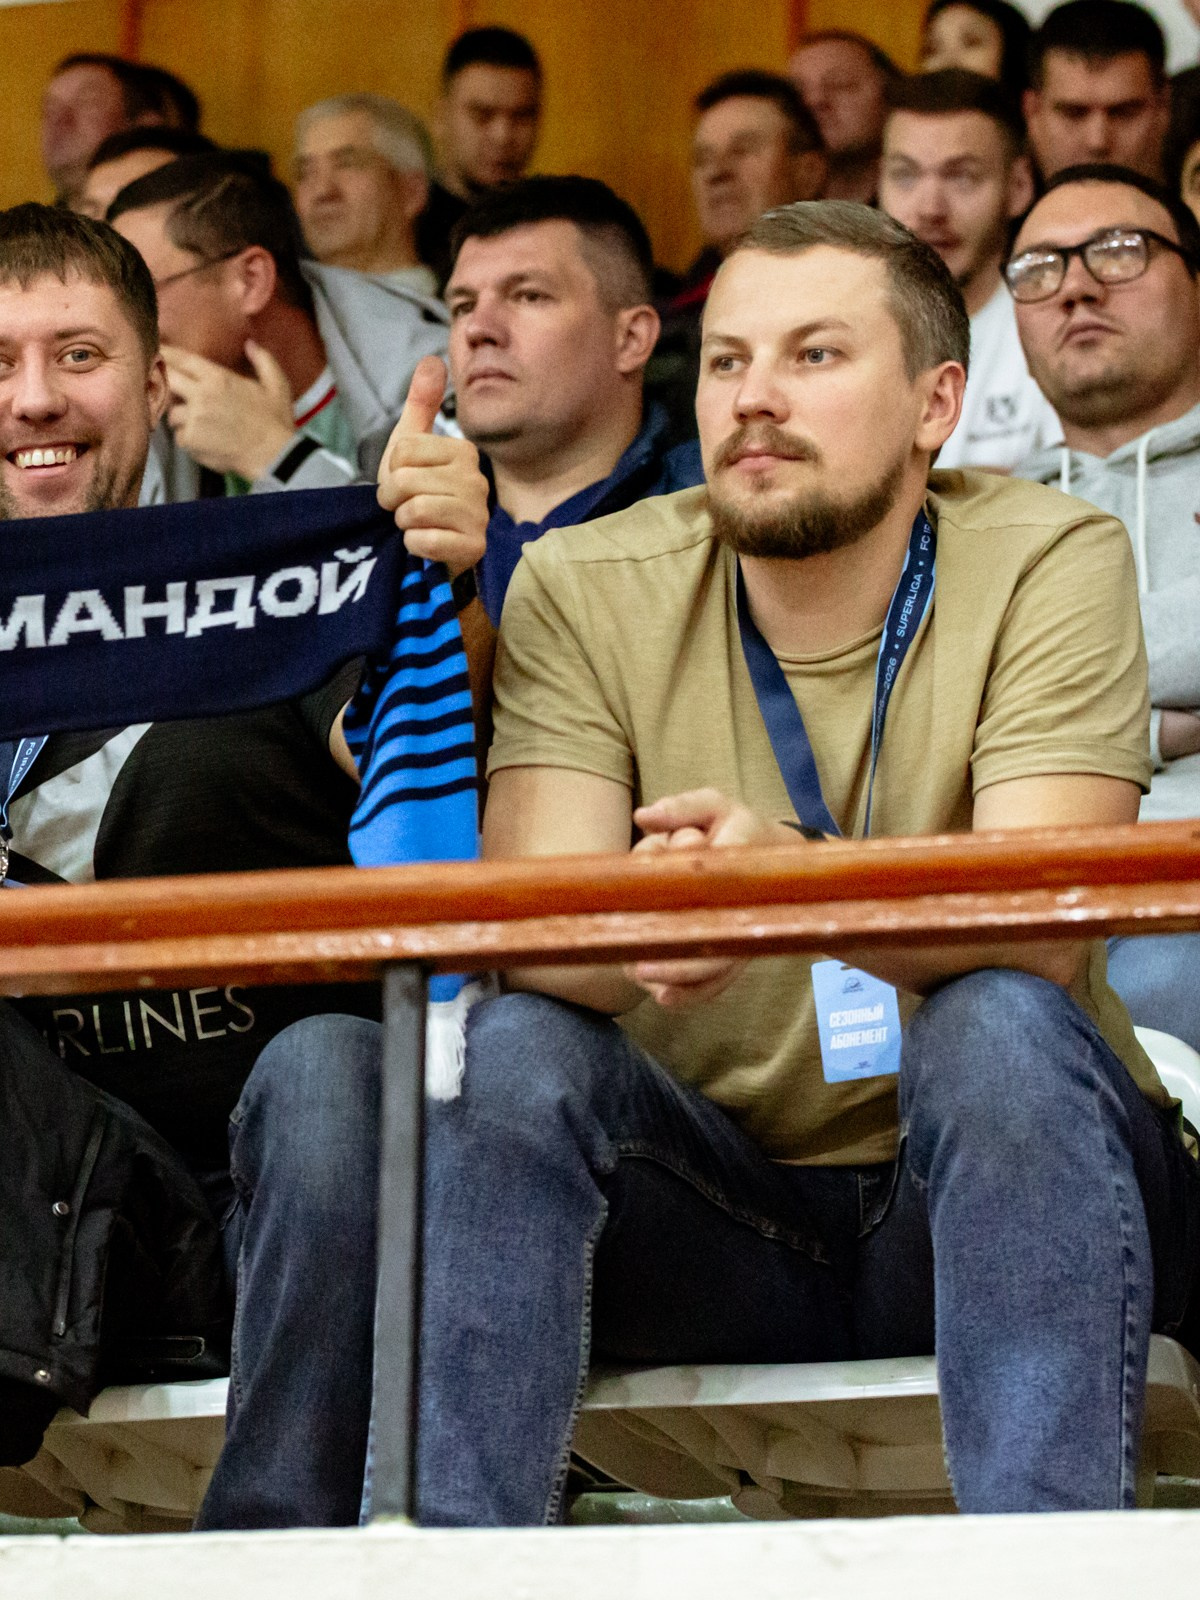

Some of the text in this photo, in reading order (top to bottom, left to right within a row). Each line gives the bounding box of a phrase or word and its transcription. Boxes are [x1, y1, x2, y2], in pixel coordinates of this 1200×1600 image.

[896, 573, 923, 638] SUPERLIGA
[919, 534, 931, 551] FC
[43, 984, 256, 1059] RLINES
[829, 1003, 885, 1029] СЕЗОННЫЙ
[829, 1026, 889, 1050] АБОНЕМЕНТ
